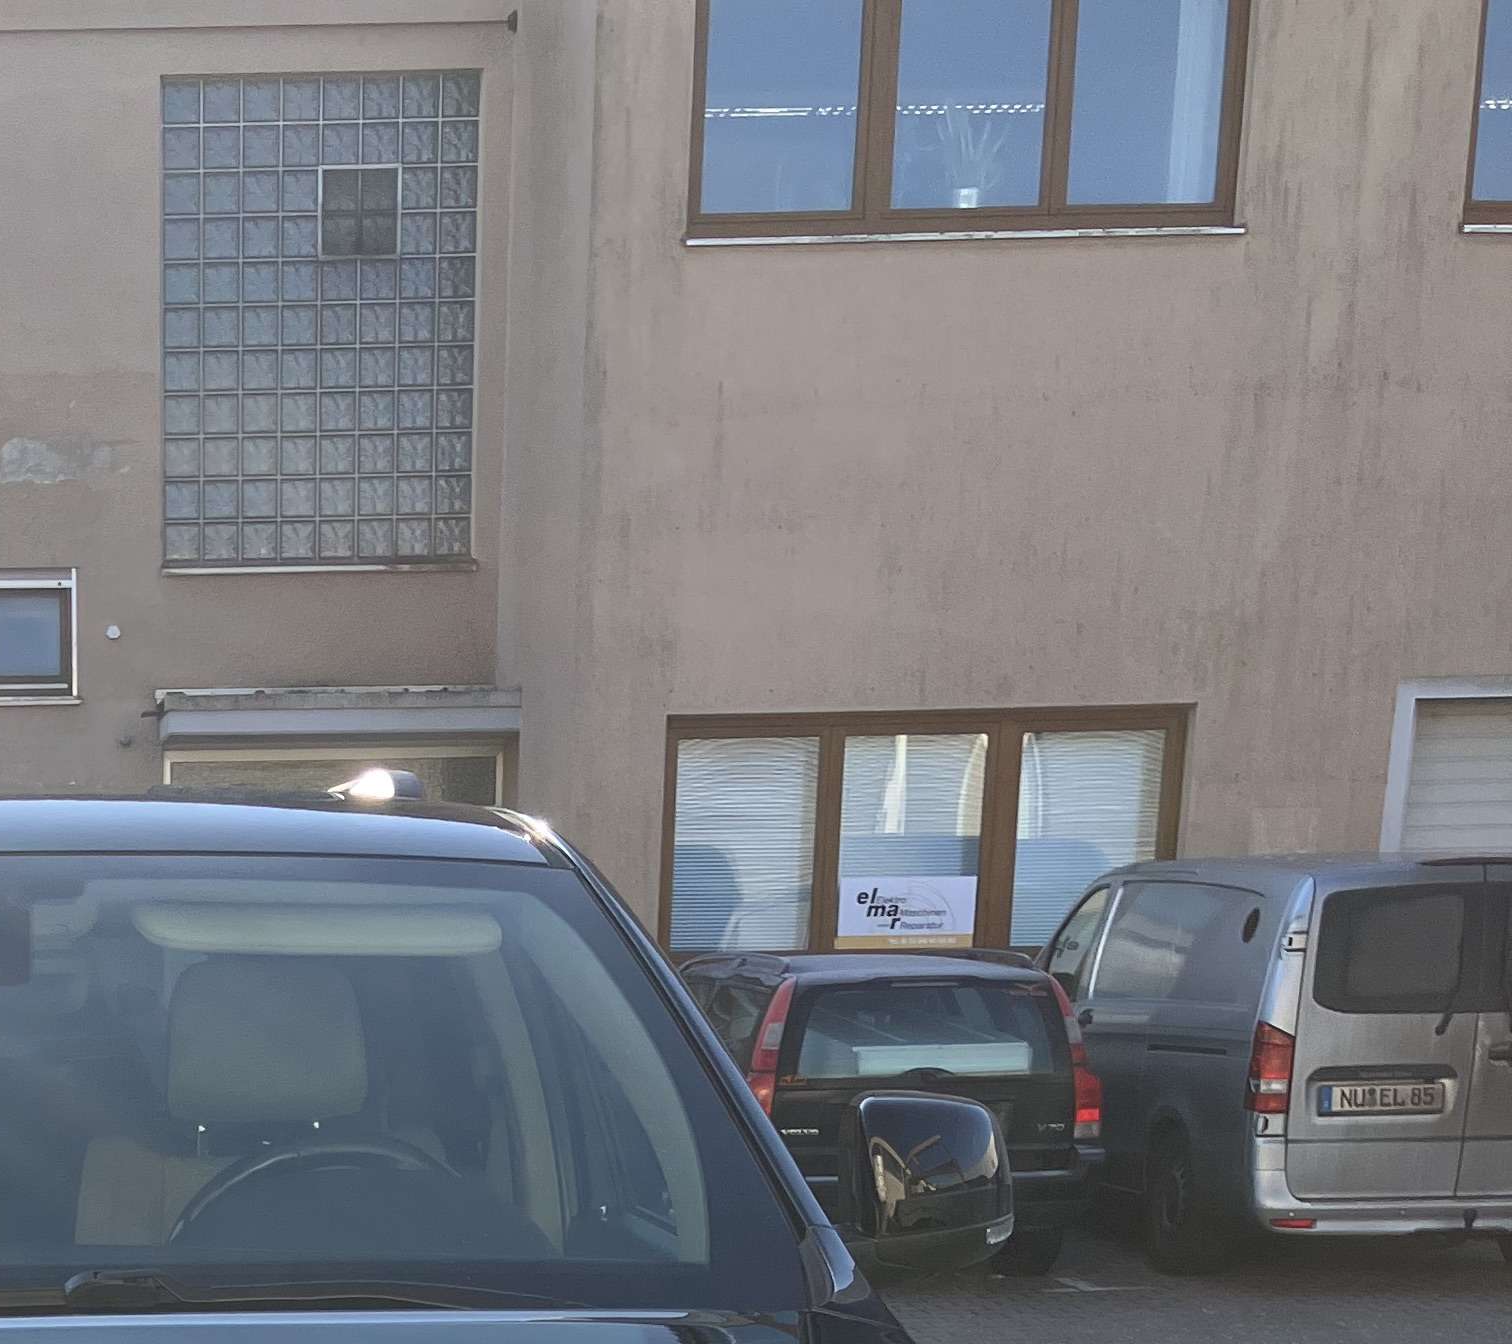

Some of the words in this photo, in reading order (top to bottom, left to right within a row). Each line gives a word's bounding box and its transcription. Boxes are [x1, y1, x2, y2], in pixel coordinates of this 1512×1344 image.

[857, 888, 878, 904] el
[866, 905, 899, 917] ma
[1339, 1088, 1366, 1108] NU
[1380, 1088, 1405, 1107] EL
[1410, 1087, 1436, 1106] 85
